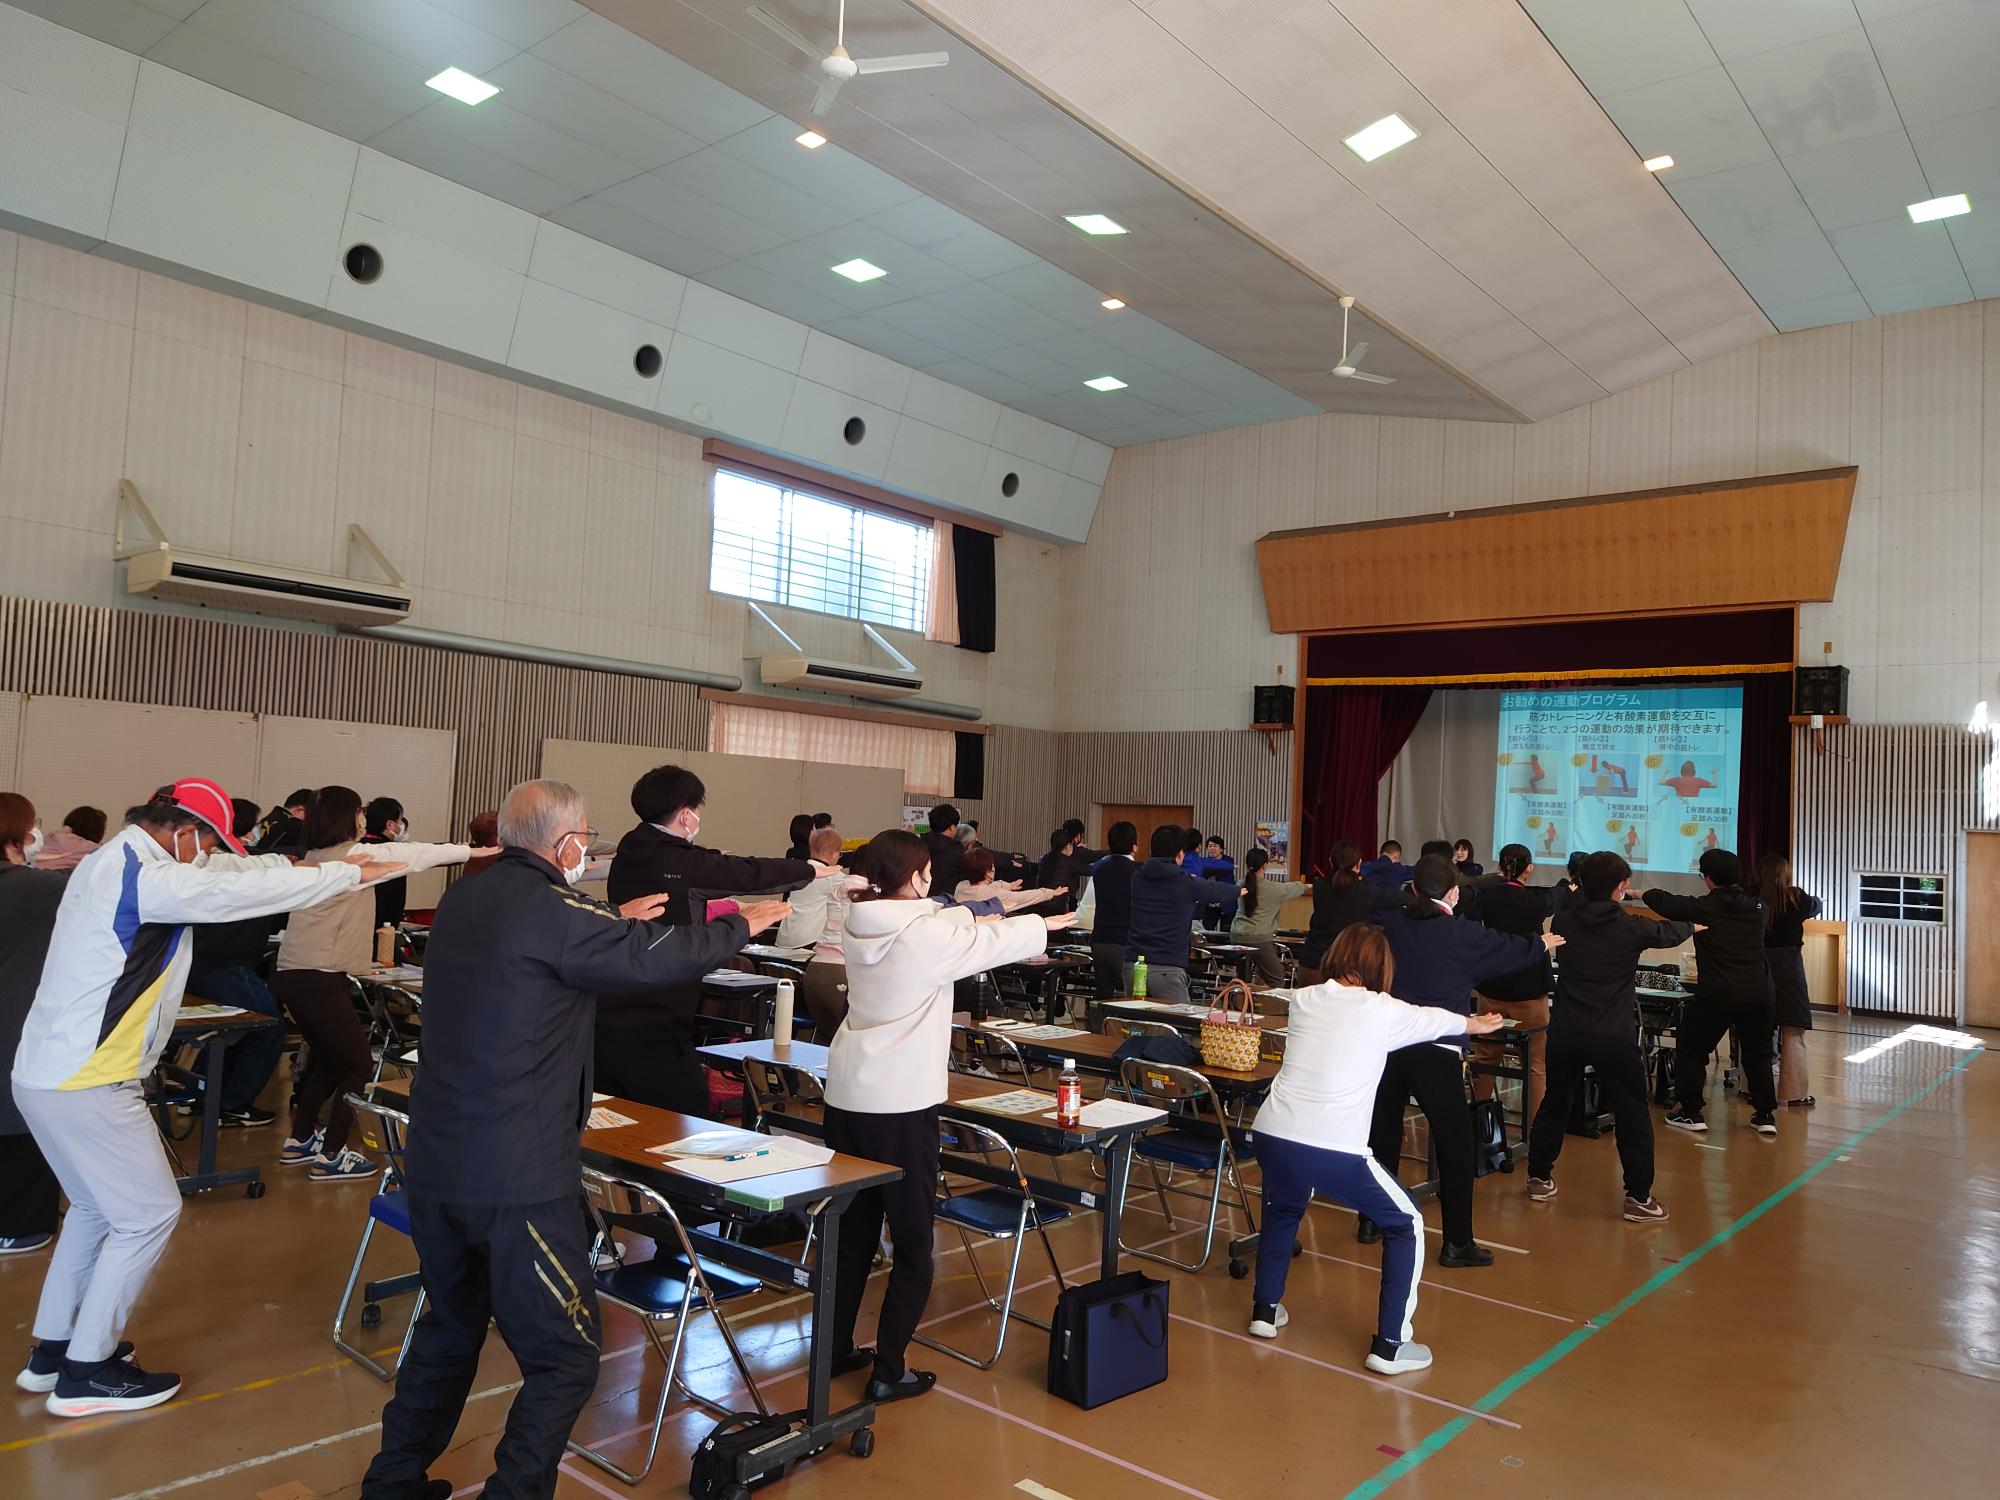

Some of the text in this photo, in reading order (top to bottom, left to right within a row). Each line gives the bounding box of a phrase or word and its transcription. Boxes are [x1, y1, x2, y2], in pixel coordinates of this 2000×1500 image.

[1503, 693, 1642, 708] お勧めの運動プログラム
[1529, 710, 1716, 722] 筋力トレーニングと有酸素運動を交互に
[337, 1153, 356, 1173] N
